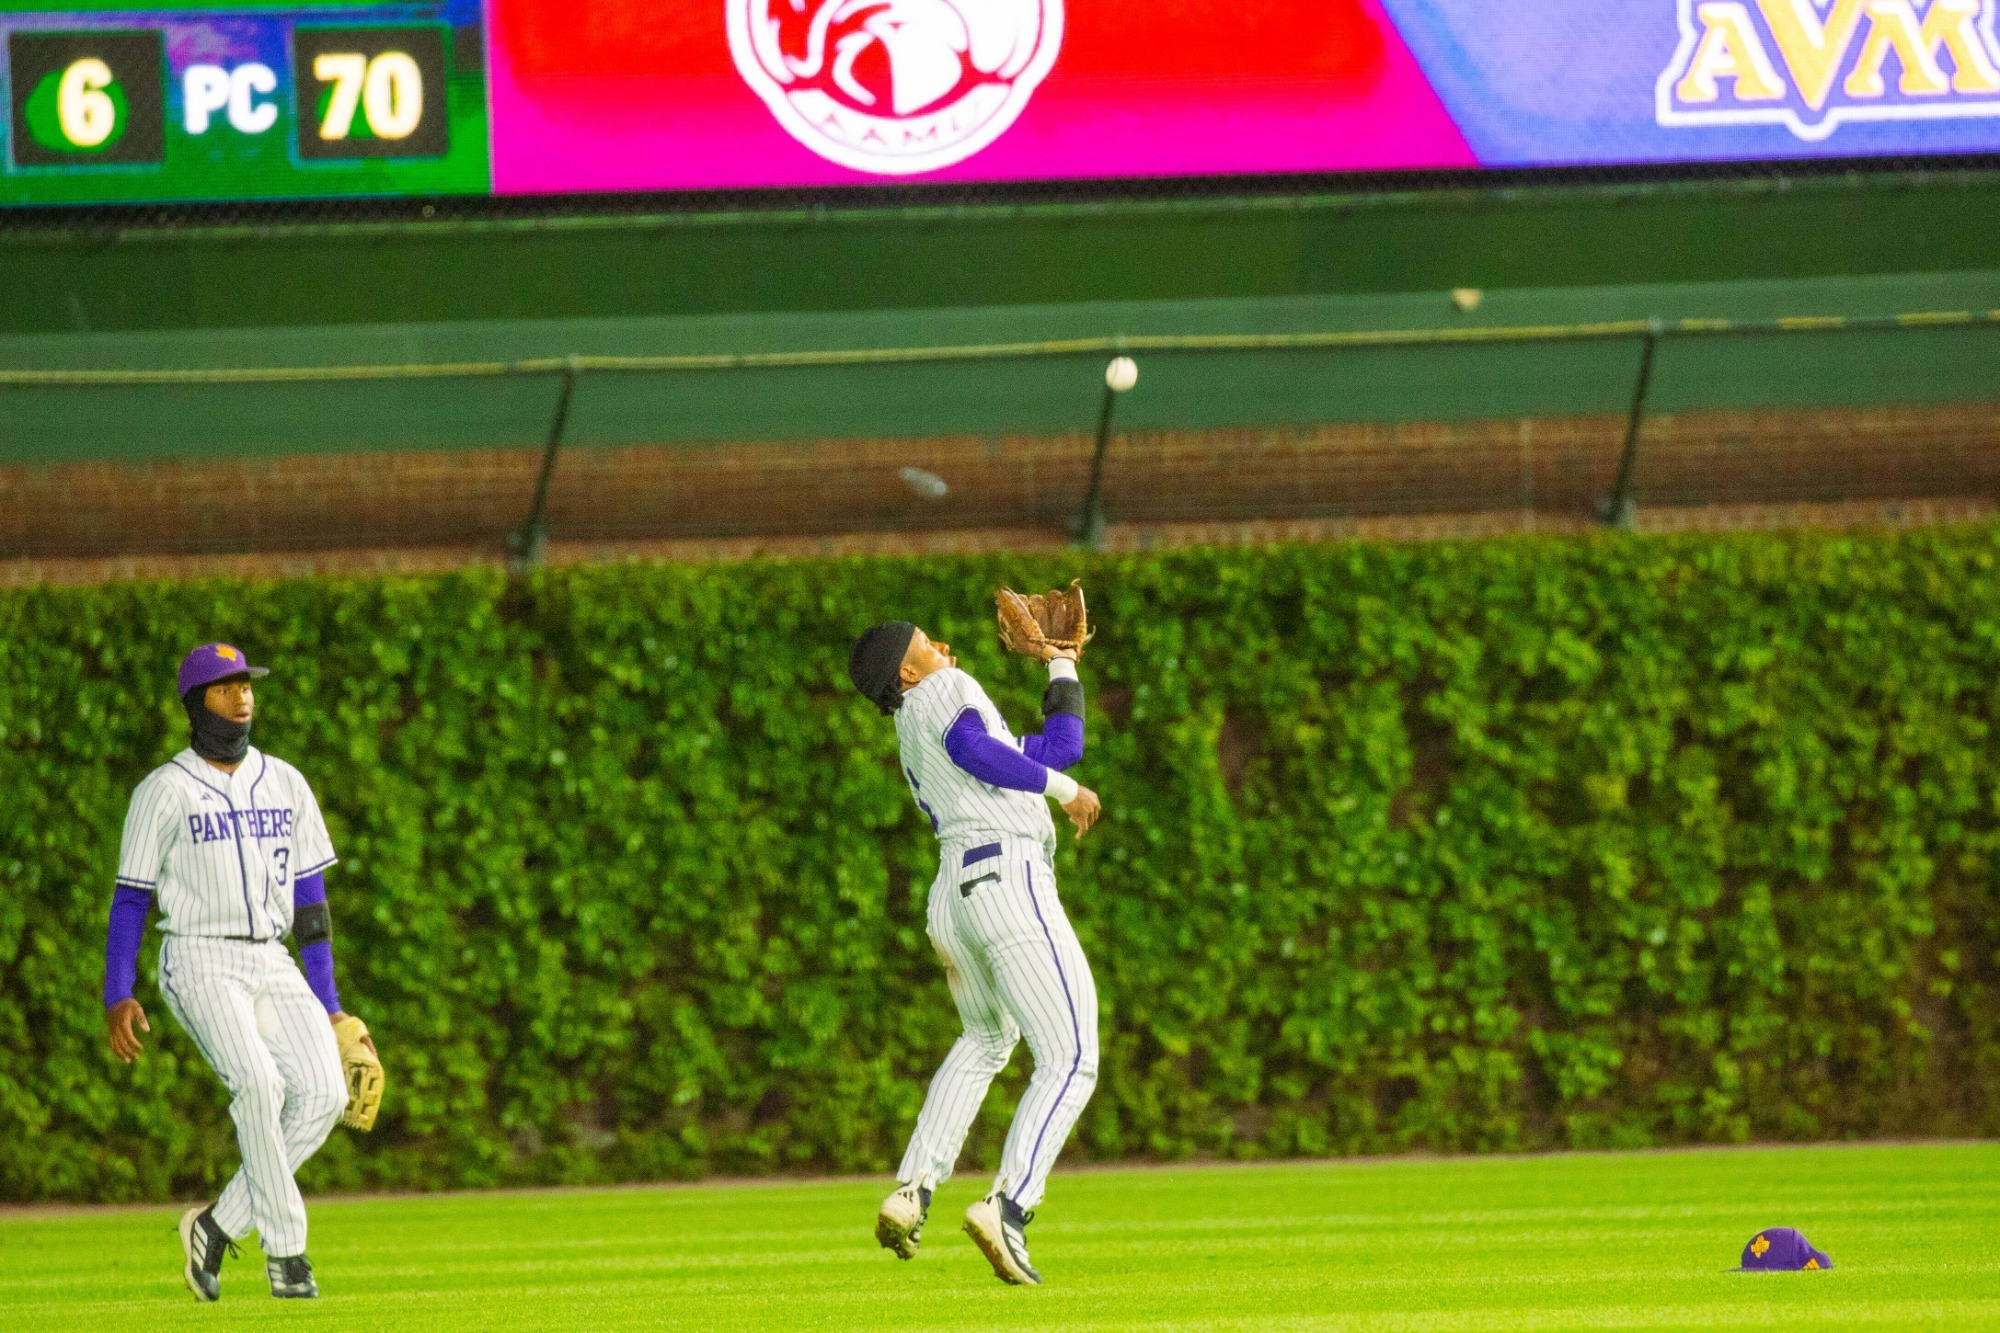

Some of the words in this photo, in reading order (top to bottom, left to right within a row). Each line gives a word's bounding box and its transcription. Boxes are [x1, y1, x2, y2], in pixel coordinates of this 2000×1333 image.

[57, 57, 115, 147] 6
[182, 62, 278, 135] PC
[312, 50, 424, 140] 70
[188, 808, 293, 845] PANTHERS
[273, 847, 290, 886] 3
